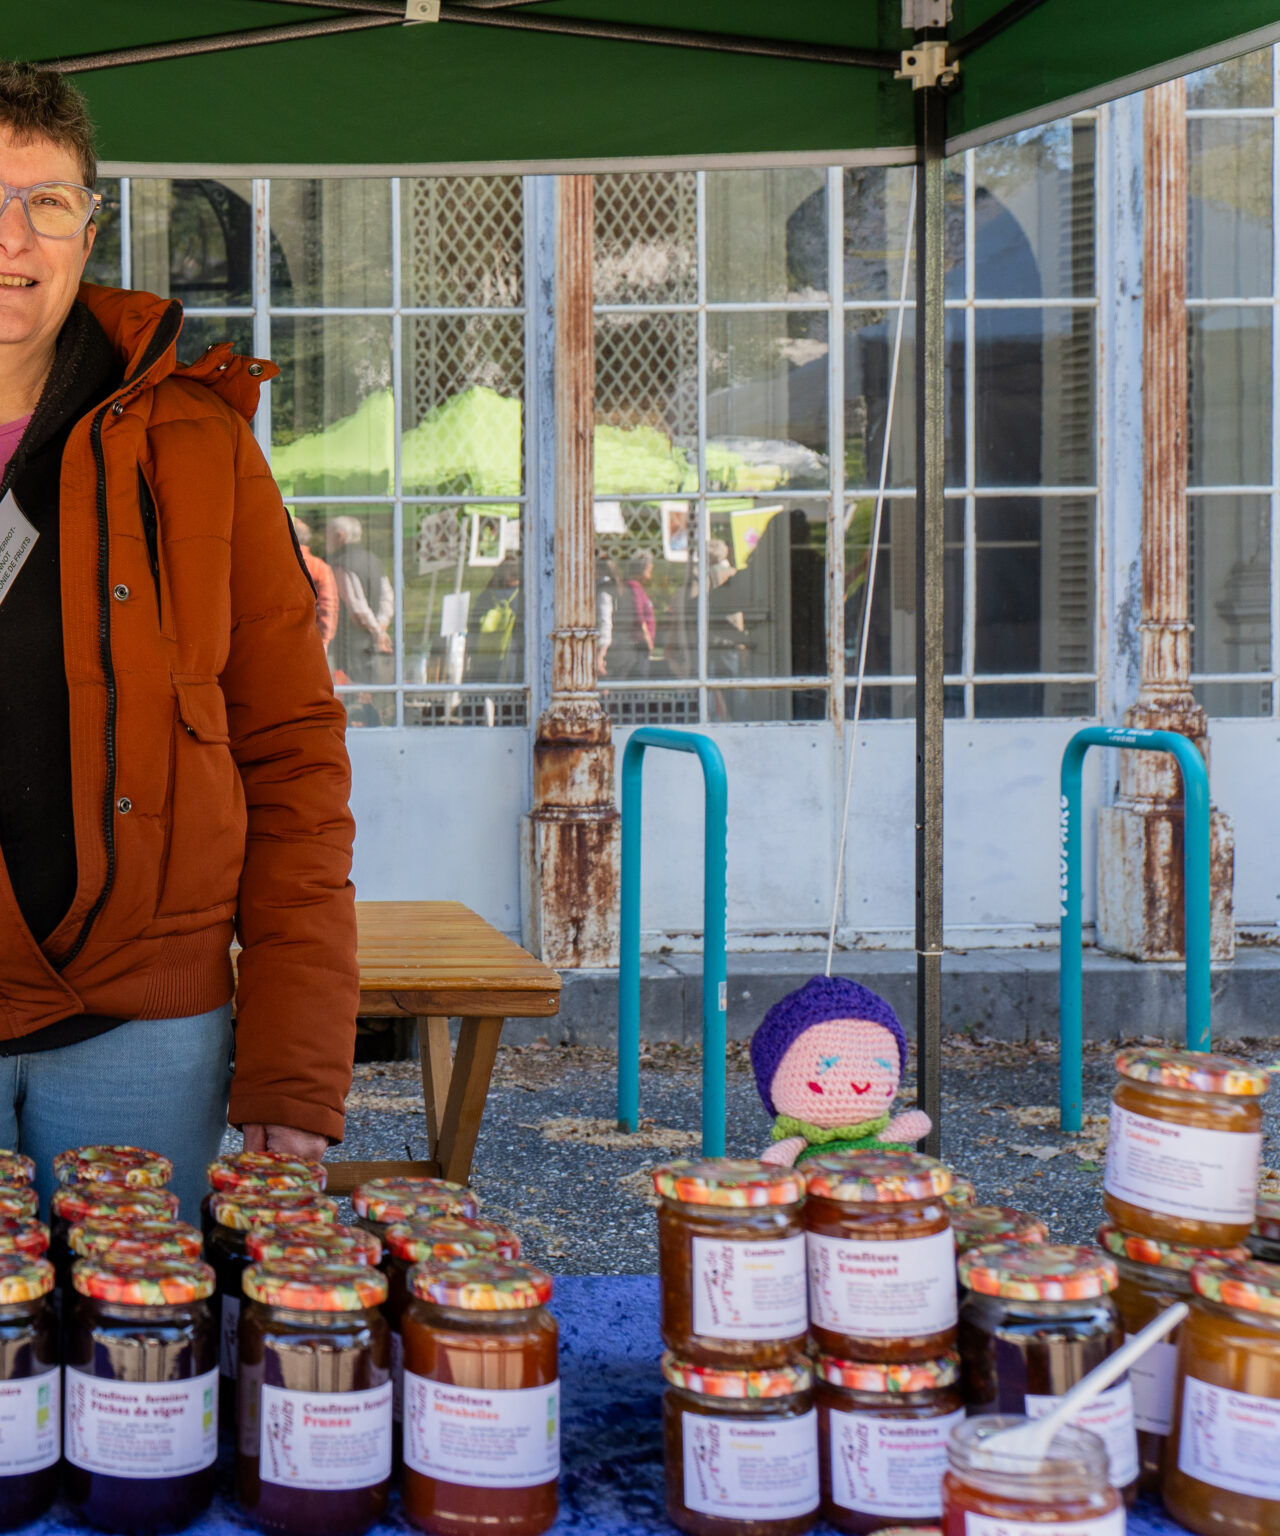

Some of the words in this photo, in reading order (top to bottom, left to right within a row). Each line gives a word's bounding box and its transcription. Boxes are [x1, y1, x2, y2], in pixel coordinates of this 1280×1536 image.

[8, 560, 17, 573] DE
[14, 536, 31, 562] FRUITS
[837, 1248, 899, 1262] Confiture
[91, 1388, 138, 1402] Confiture
[145, 1393, 189, 1403] fermière
[434, 1389, 491, 1406] Confiture
[134, 1406, 148, 1416] de
[303, 1402, 359, 1414] Confiture
[303, 1415, 351, 1427] Prunes
[879, 1426, 938, 1437] Confiture
